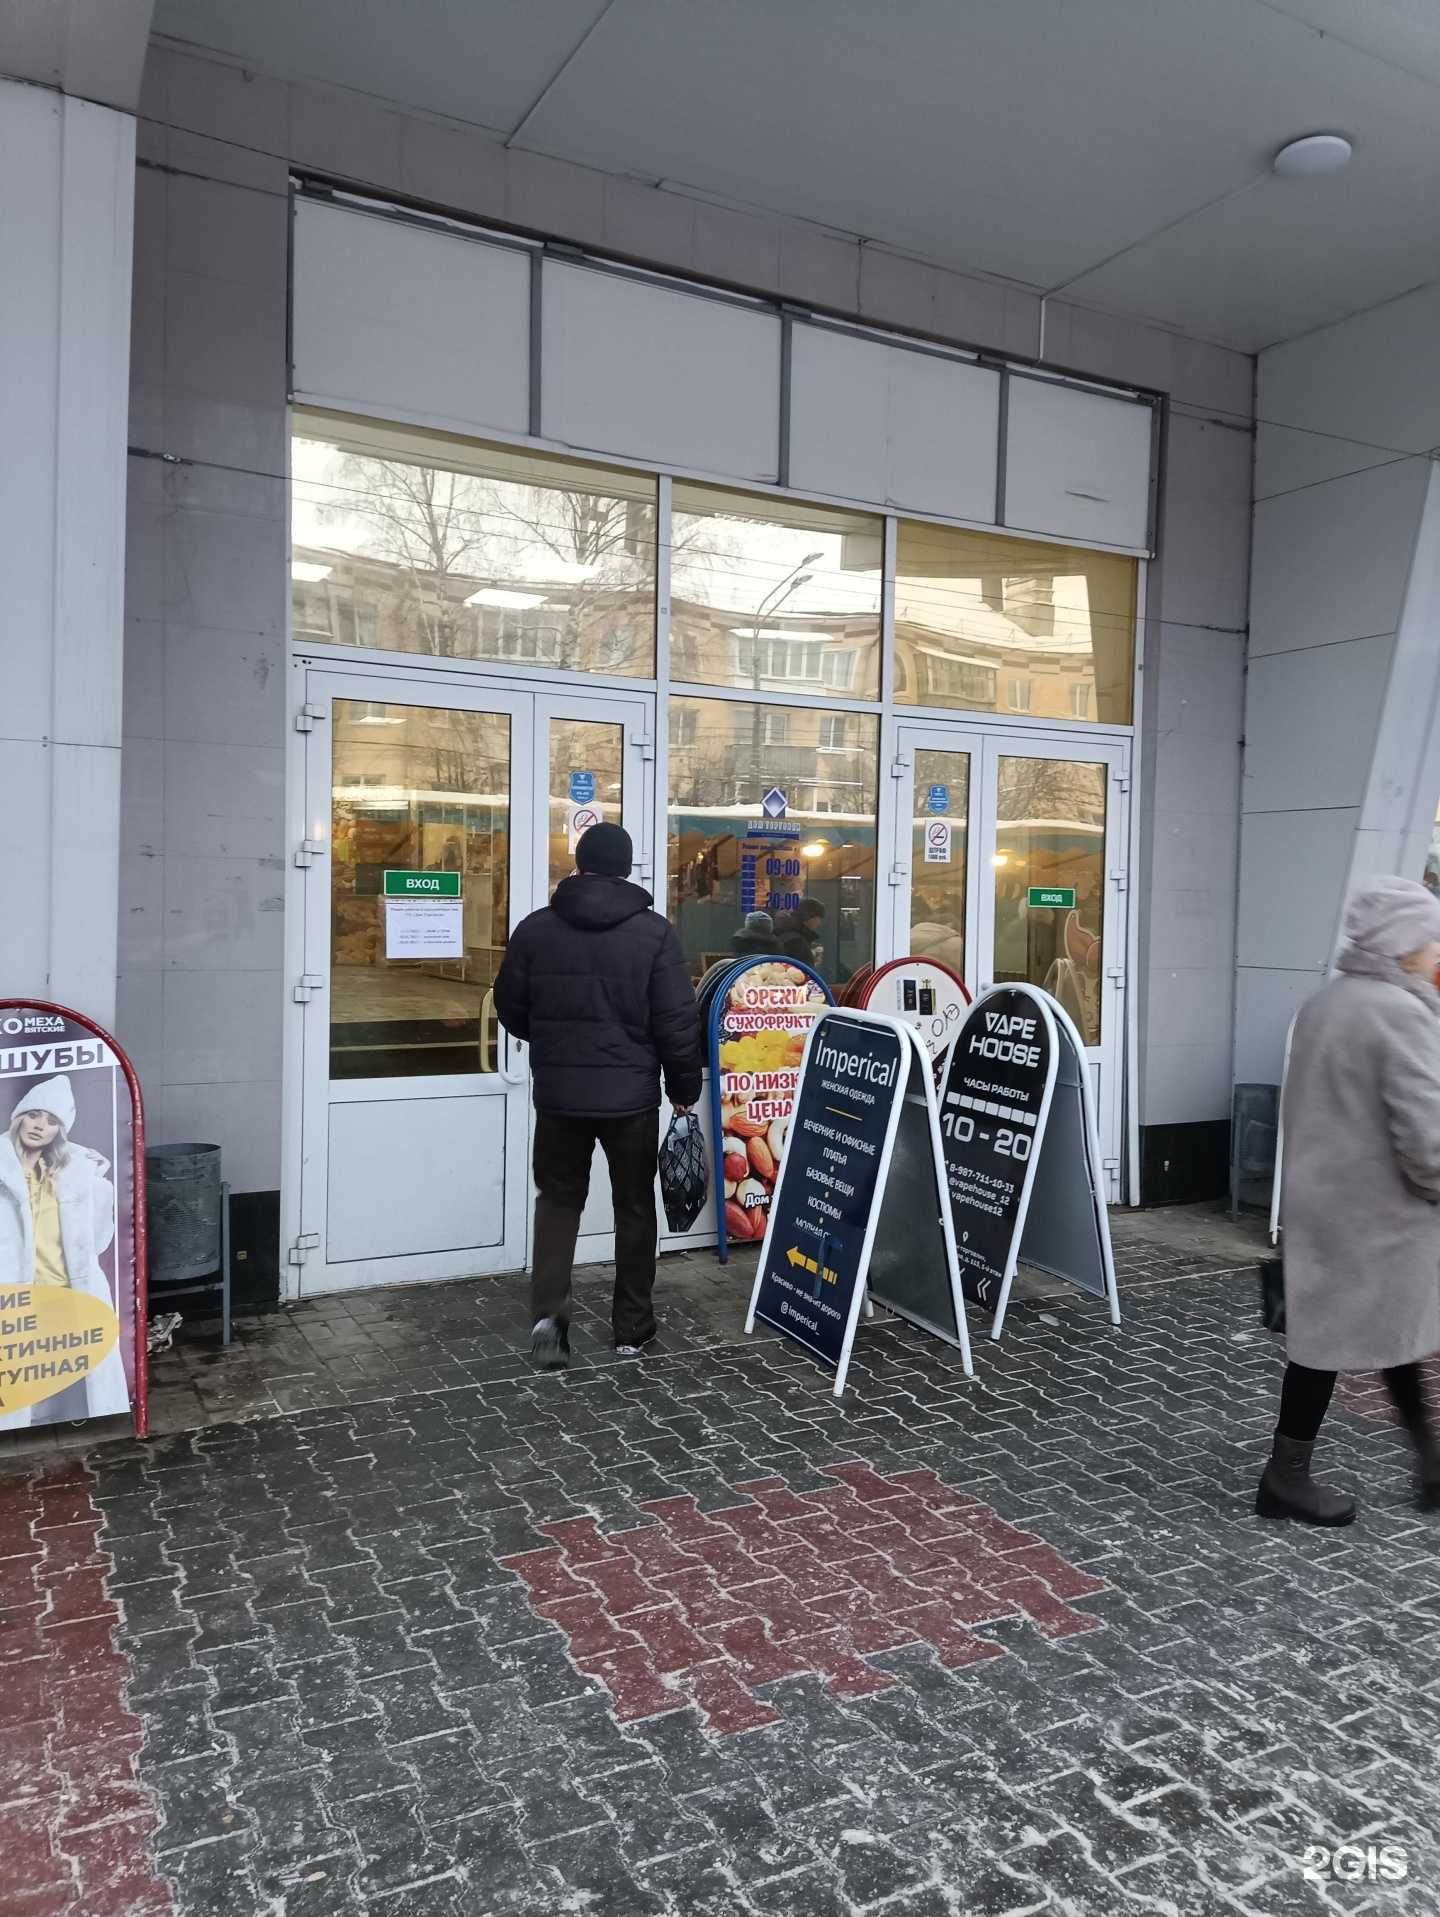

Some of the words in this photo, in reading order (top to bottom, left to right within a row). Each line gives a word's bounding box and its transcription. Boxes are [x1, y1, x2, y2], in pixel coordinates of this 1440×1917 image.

[766, 858, 800, 876] 09:00
[406, 878, 440, 890] ВХОД
[1040, 893, 1063, 903] ВХОД
[746, 987, 806, 1006] ОРЕХИ
[24, 1016, 65, 1027] МЕХА
[24, 1026, 66, 1034] ВЯТСКИЕ
[726, 1015, 816, 1031] СУХОФРУКТ
[985, 1011, 1038, 1040] VAPE
[0, 1043, 104, 1074] ШУБЫ
[815, 1039, 898, 1088] Imperical
[726, 1074, 751, 1092] ПО
[821, 1079, 848, 1096] ЖЕНСКАЯ
[849, 1088, 875, 1105] ОДЕЖДА
[963, 1076, 991, 1092] ЧАСЫ
[991, 1083, 1030, 1102] РАБОТЫ
[803, 1119, 835, 1140] ВЕЧЕРНИЕ
[842, 1134, 877, 1156] ОФИСНЫЕ
[942, 1112, 975, 1143] 10
[993, 1128, 1033, 1162] 20
[822, 1147, 848, 1166] ПЛАТЬЯ
[806, 1166, 836, 1188] БАЗОВЫЕ
[835, 1179, 855, 1198] ВЕЩИ
[745, 1193, 770, 1208] Дом
[807, 1195, 842, 1220] КОСТЮМЫ
[771, 1271, 794, 1291] Красиво
[820, 1303, 842, 1321] дорого
[0, 1326, 104, 1361] ТИЧНЫЕ
